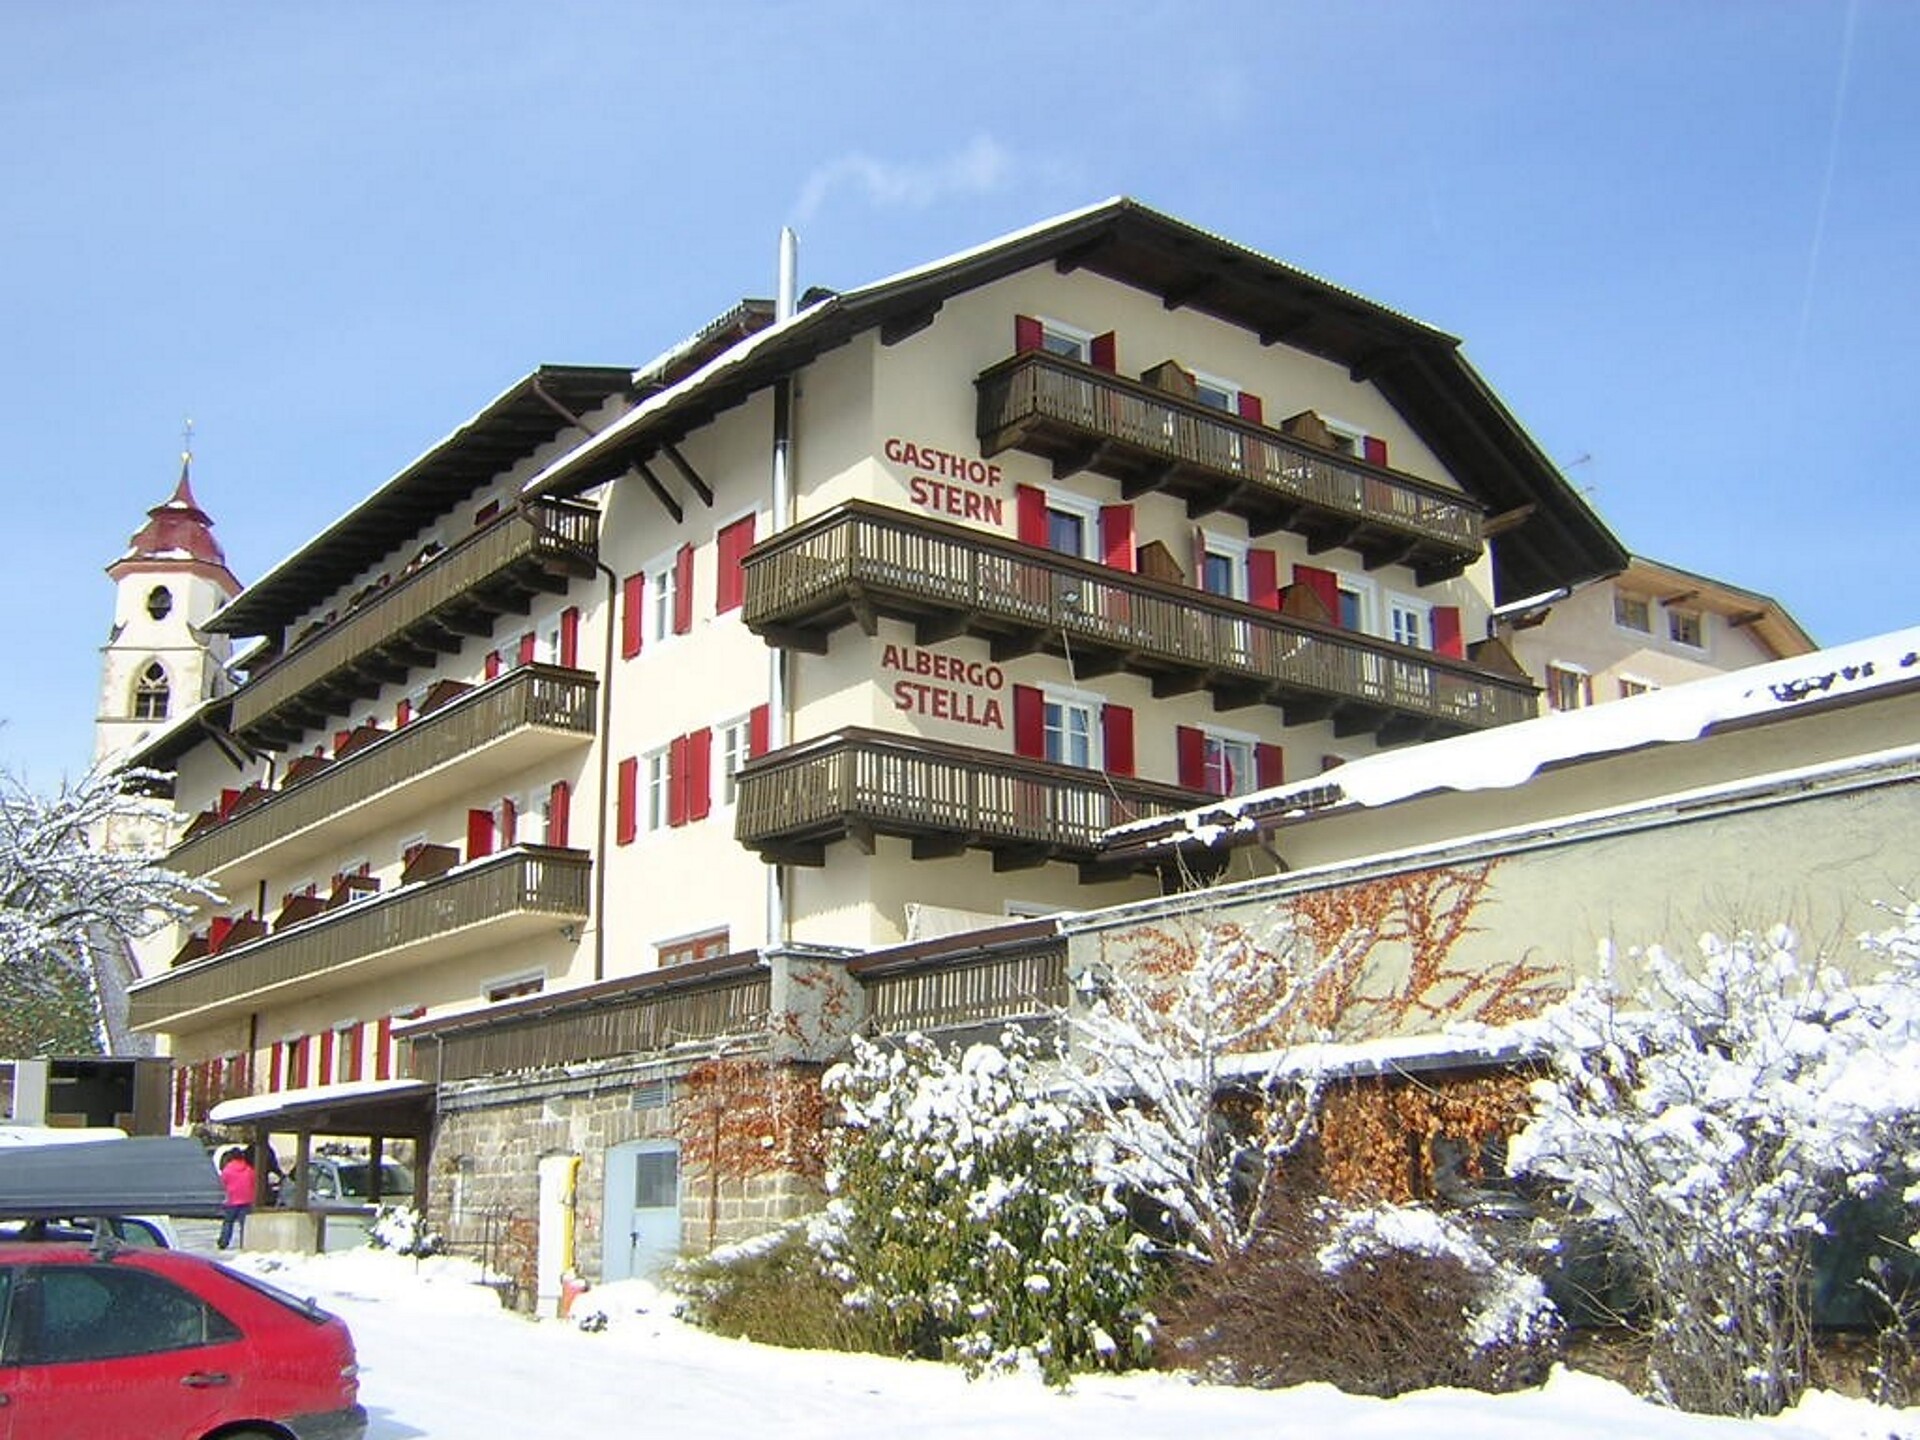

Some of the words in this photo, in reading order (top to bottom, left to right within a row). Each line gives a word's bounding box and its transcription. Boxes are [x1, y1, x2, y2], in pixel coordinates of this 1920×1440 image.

[885, 438, 1001, 487] GASTHOF
[910, 476, 1003, 526] STERN
[882, 644, 1004, 690] ALBERGO
[894, 680, 1004, 730] STELLA
